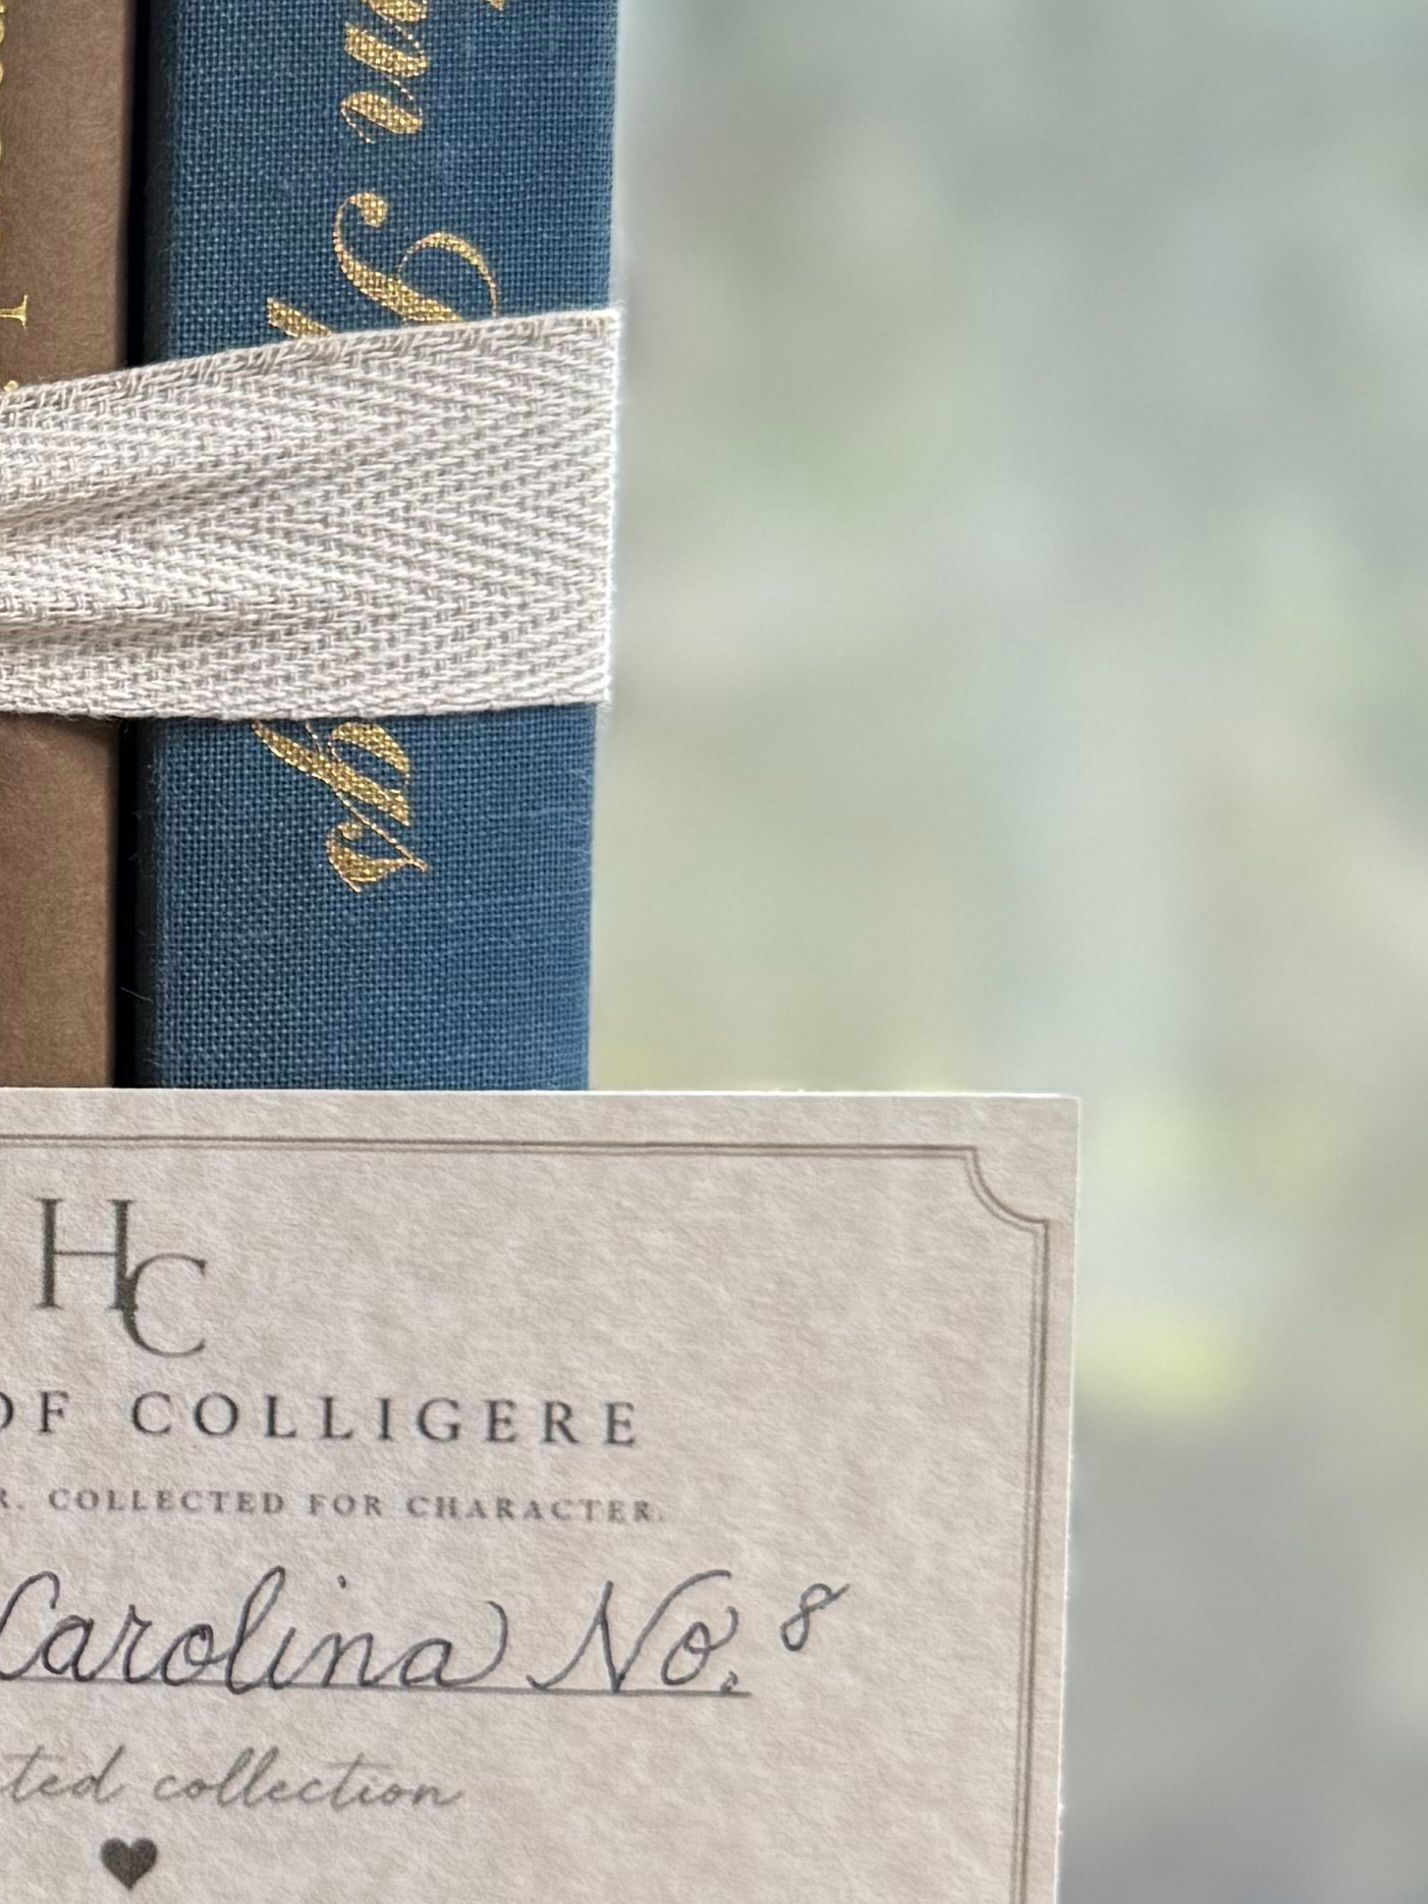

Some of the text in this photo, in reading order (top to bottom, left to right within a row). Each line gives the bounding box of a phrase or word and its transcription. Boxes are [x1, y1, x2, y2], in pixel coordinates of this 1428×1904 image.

[129, 1390, 638, 1449] COLLIGERE
[47, 1488, 286, 1516] COLLECTED
[308, 1493, 383, 1517] FOR
[405, 1495, 665, 1524] CHARACTER.
[526, 1568, 739, 1696] No.
[779, 1582, 850, 1654] 8
[152, 1746, 464, 1813] collection
